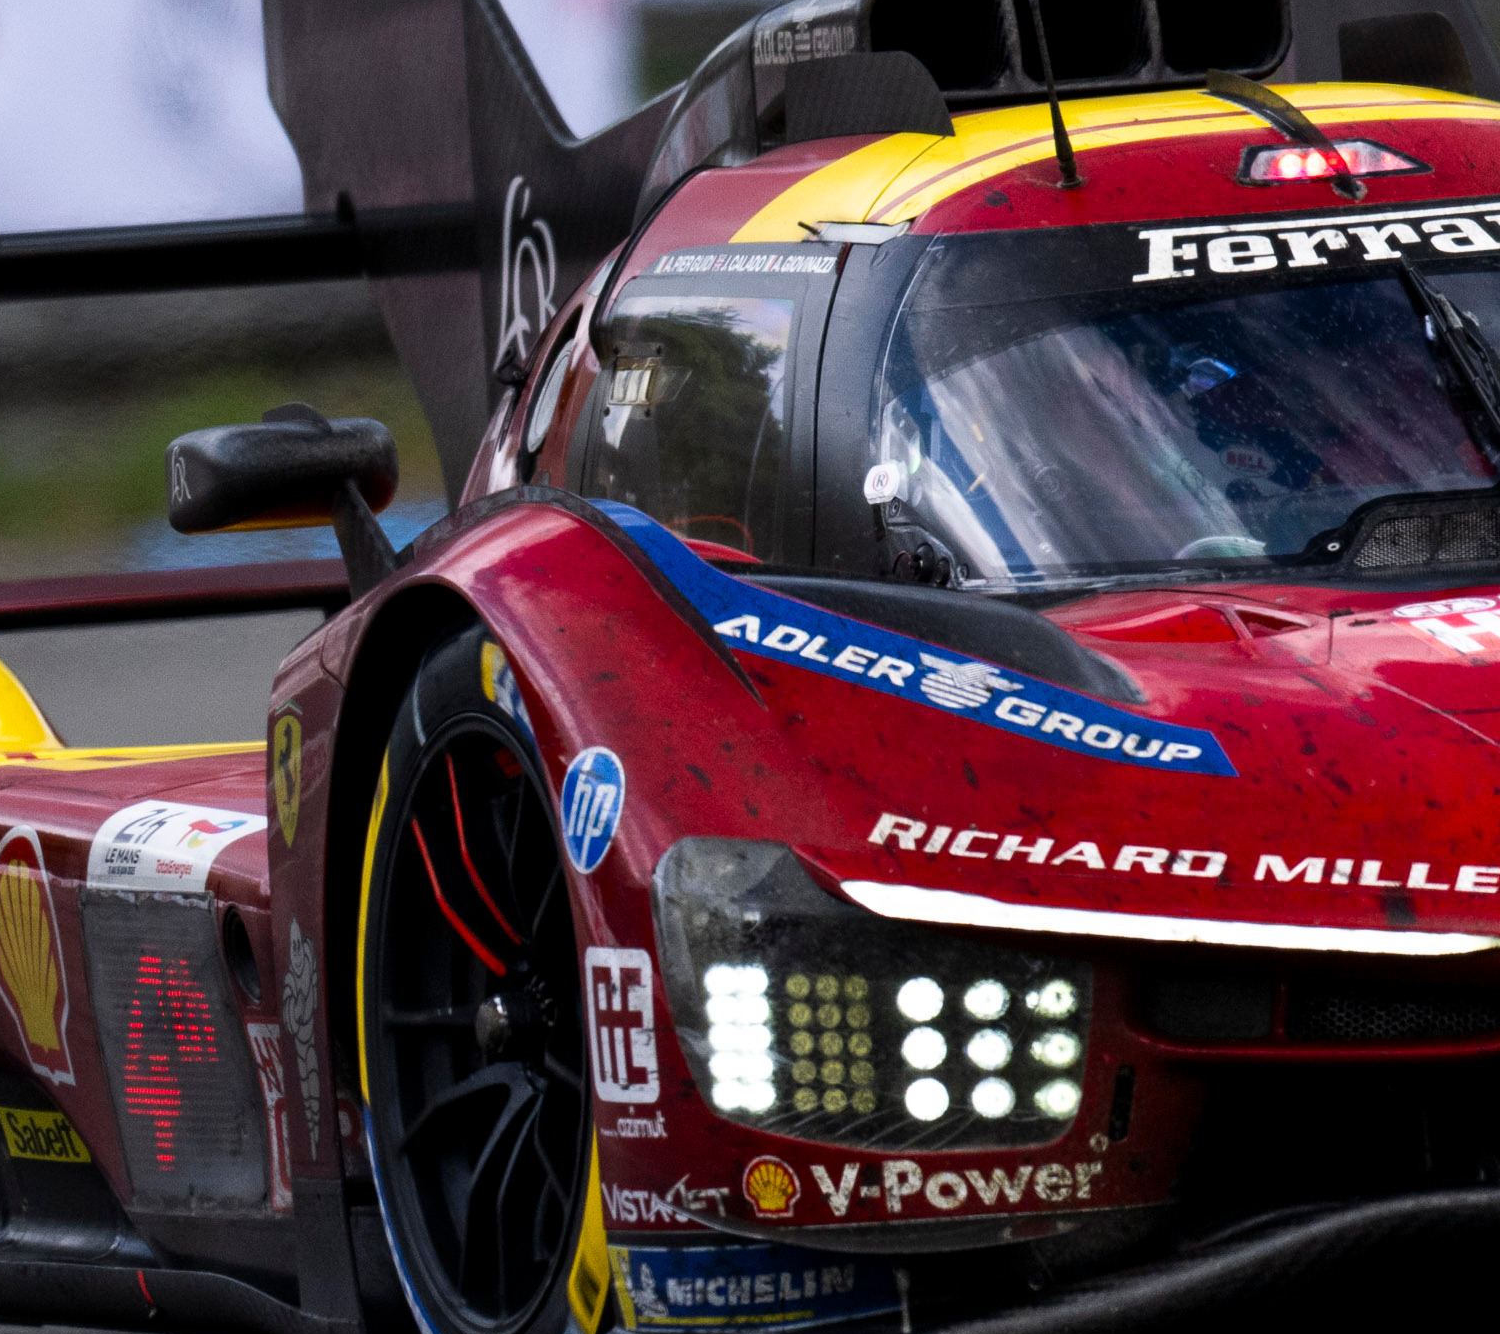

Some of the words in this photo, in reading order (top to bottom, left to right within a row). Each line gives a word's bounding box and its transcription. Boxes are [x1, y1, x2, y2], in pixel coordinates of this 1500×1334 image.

[754, 28, 795, 65] ADLER
[713, 613, 916, 688] ADLER
[994, 695, 1203, 763] GROUP
[117, 848, 141, 865] MANS
[868, 812, 1226, 878] RICHARD
[5, 1111, 81, 1158] Sabelt
[809, 1158, 1103, 1218] V-Power
[666, 1265, 856, 1307] MICHELIN
